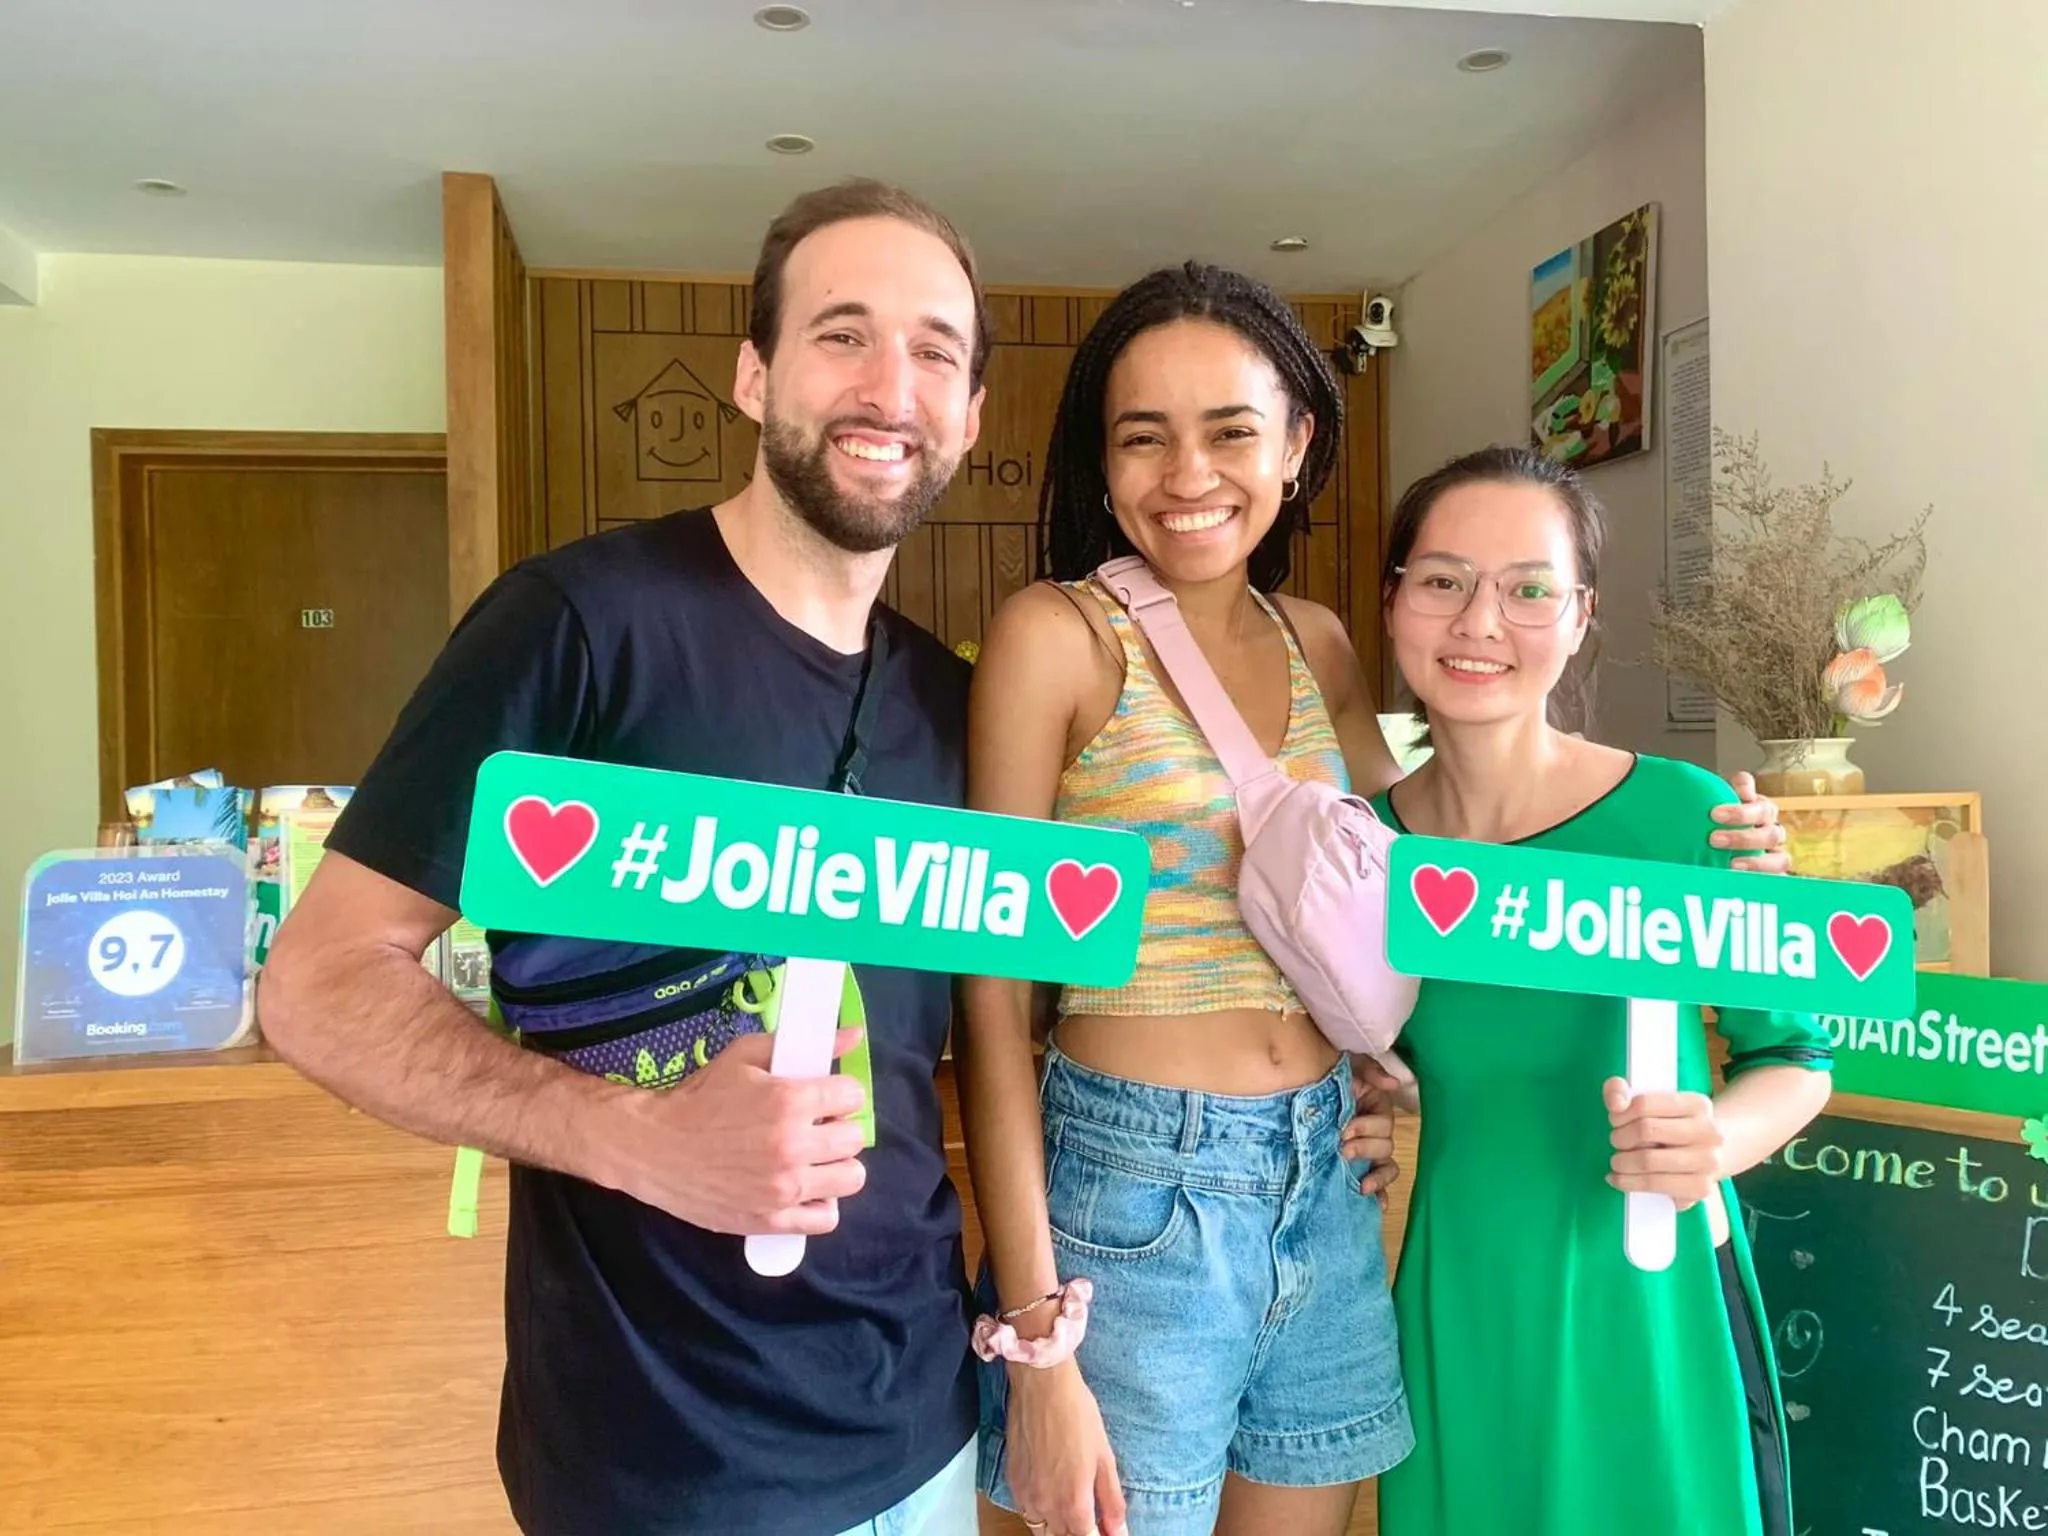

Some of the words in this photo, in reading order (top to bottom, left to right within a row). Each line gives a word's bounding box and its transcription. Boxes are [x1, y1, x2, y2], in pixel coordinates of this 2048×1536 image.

[967, 450, 1031, 486] Hoi
[303, 611, 332, 626] 103
[80, 891, 110, 902] Villa
[113, 889, 136, 901] Hoi
[139, 888, 159, 899] An
[161, 886, 229, 899] Homestay
[98, 872, 133, 884] 2023
[137, 870, 180, 883] Award
[1812, 1010, 2048, 1075] oiAnStreet
[1763, 1138, 1936, 1190] come
[1946, 1147, 2009, 1202] to
[1932, 1282, 1963, 1327] 4
[1926, 1346, 1951, 1388] 7
[1959, 1364, 2048, 1408] sea
[1912, 1406, 2031, 1466] Cham
